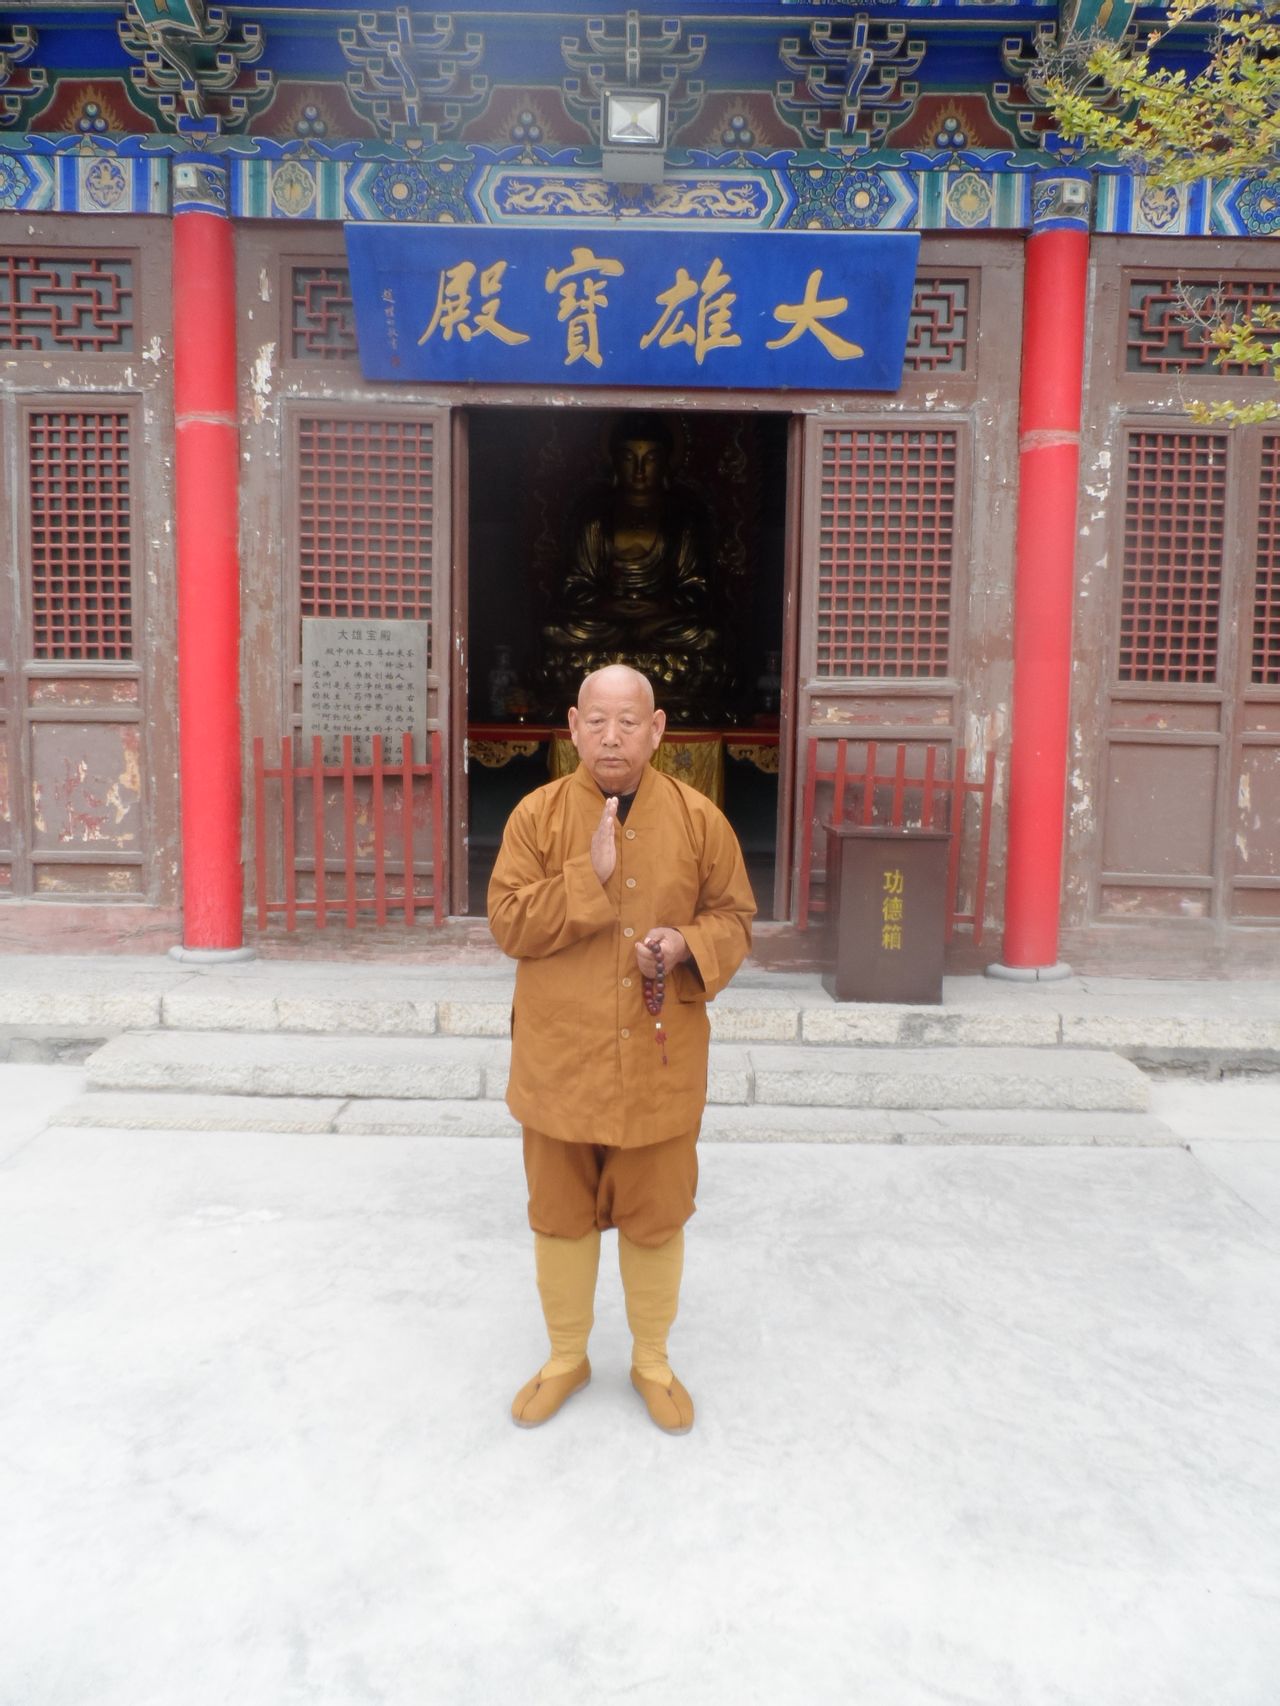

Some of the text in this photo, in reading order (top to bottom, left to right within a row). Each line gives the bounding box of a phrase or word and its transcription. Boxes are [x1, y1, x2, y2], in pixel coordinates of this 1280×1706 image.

[417, 248, 865, 368] 大雄寶殿
[337, 629, 392, 641] 大雄宝殿
[882, 869, 904, 950] 功德箱
